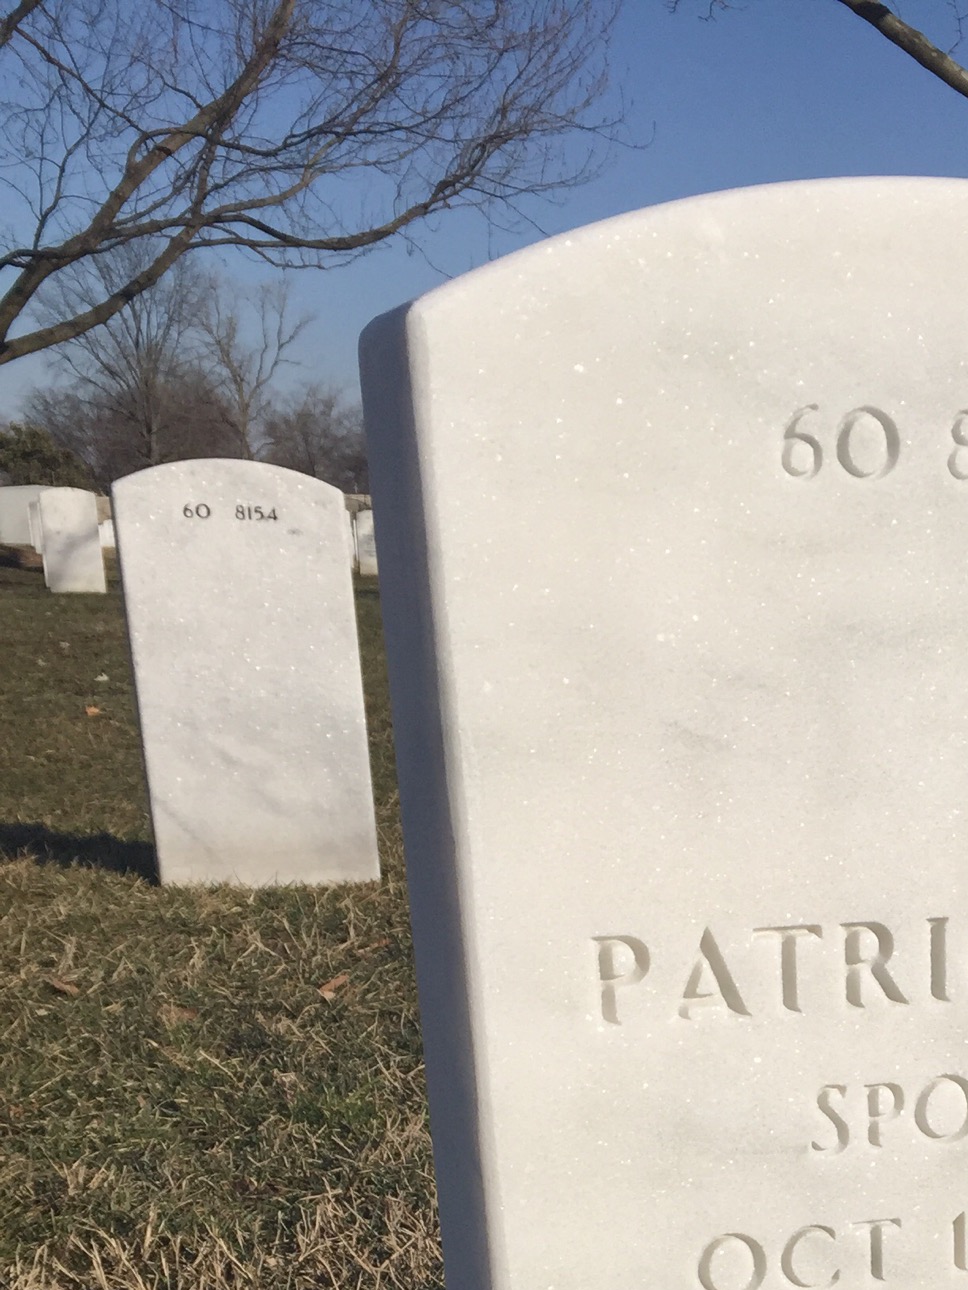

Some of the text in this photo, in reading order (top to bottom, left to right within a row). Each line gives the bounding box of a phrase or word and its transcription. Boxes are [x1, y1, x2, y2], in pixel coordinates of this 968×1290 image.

[780, 403, 899, 480] 60
[182, 502, 278, 521] 60 8154
